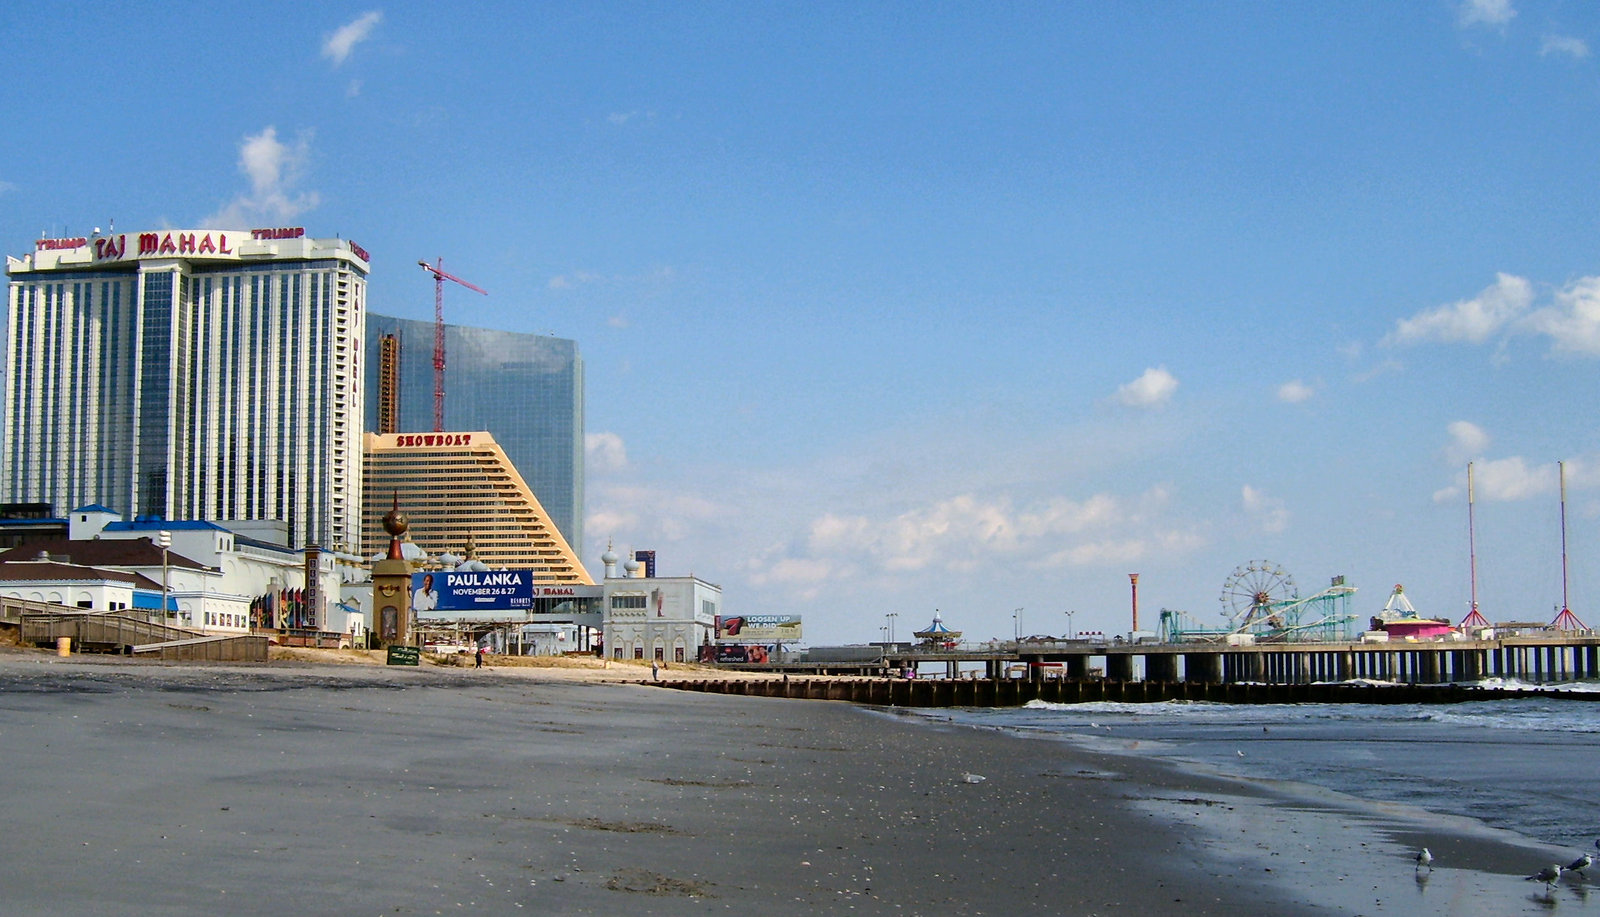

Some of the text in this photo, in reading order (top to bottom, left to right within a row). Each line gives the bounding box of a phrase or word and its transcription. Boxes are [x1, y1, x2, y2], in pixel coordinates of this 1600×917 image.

[251, 227, 305, 240] TRUMP
[36, 237, 87, 251] TRUMP
[94, 232, 233, 260] TAJ MAHAL
[396, 434, 471, 447] SHOWBOAT
[447, 573, 522, 586] PAUL ANKA
[452, 587, 516, 596] NOVEMBER 26 & 27
[543, 588, 574, 596] MAHAL
